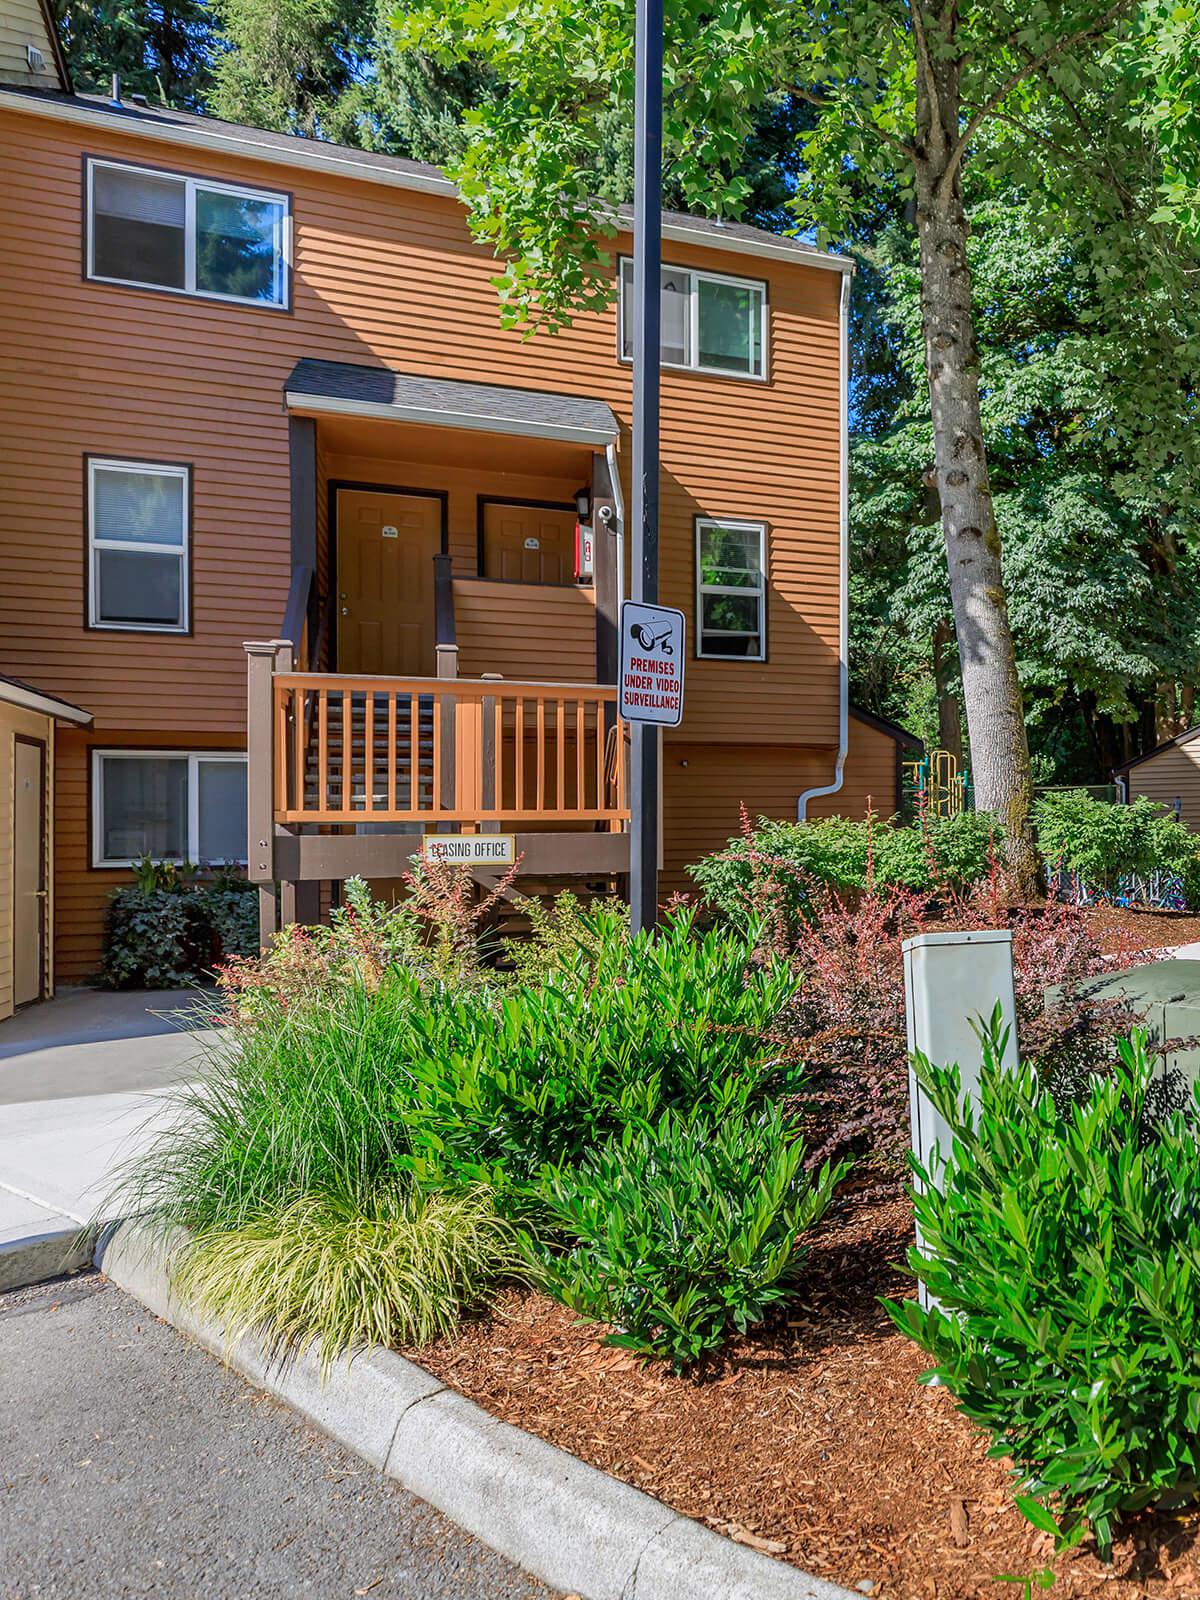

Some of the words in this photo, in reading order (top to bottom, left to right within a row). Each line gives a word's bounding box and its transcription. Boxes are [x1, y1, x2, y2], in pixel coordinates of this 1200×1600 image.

[630, 657, 675, 676] PREMISES
[624, 673, 652, 690] UNDER
[656, 677, 679, 693] VIDEO
[624, 691, 679, 710] SURVEILLANCE
[474, 842, 506, 857] OFFICE
